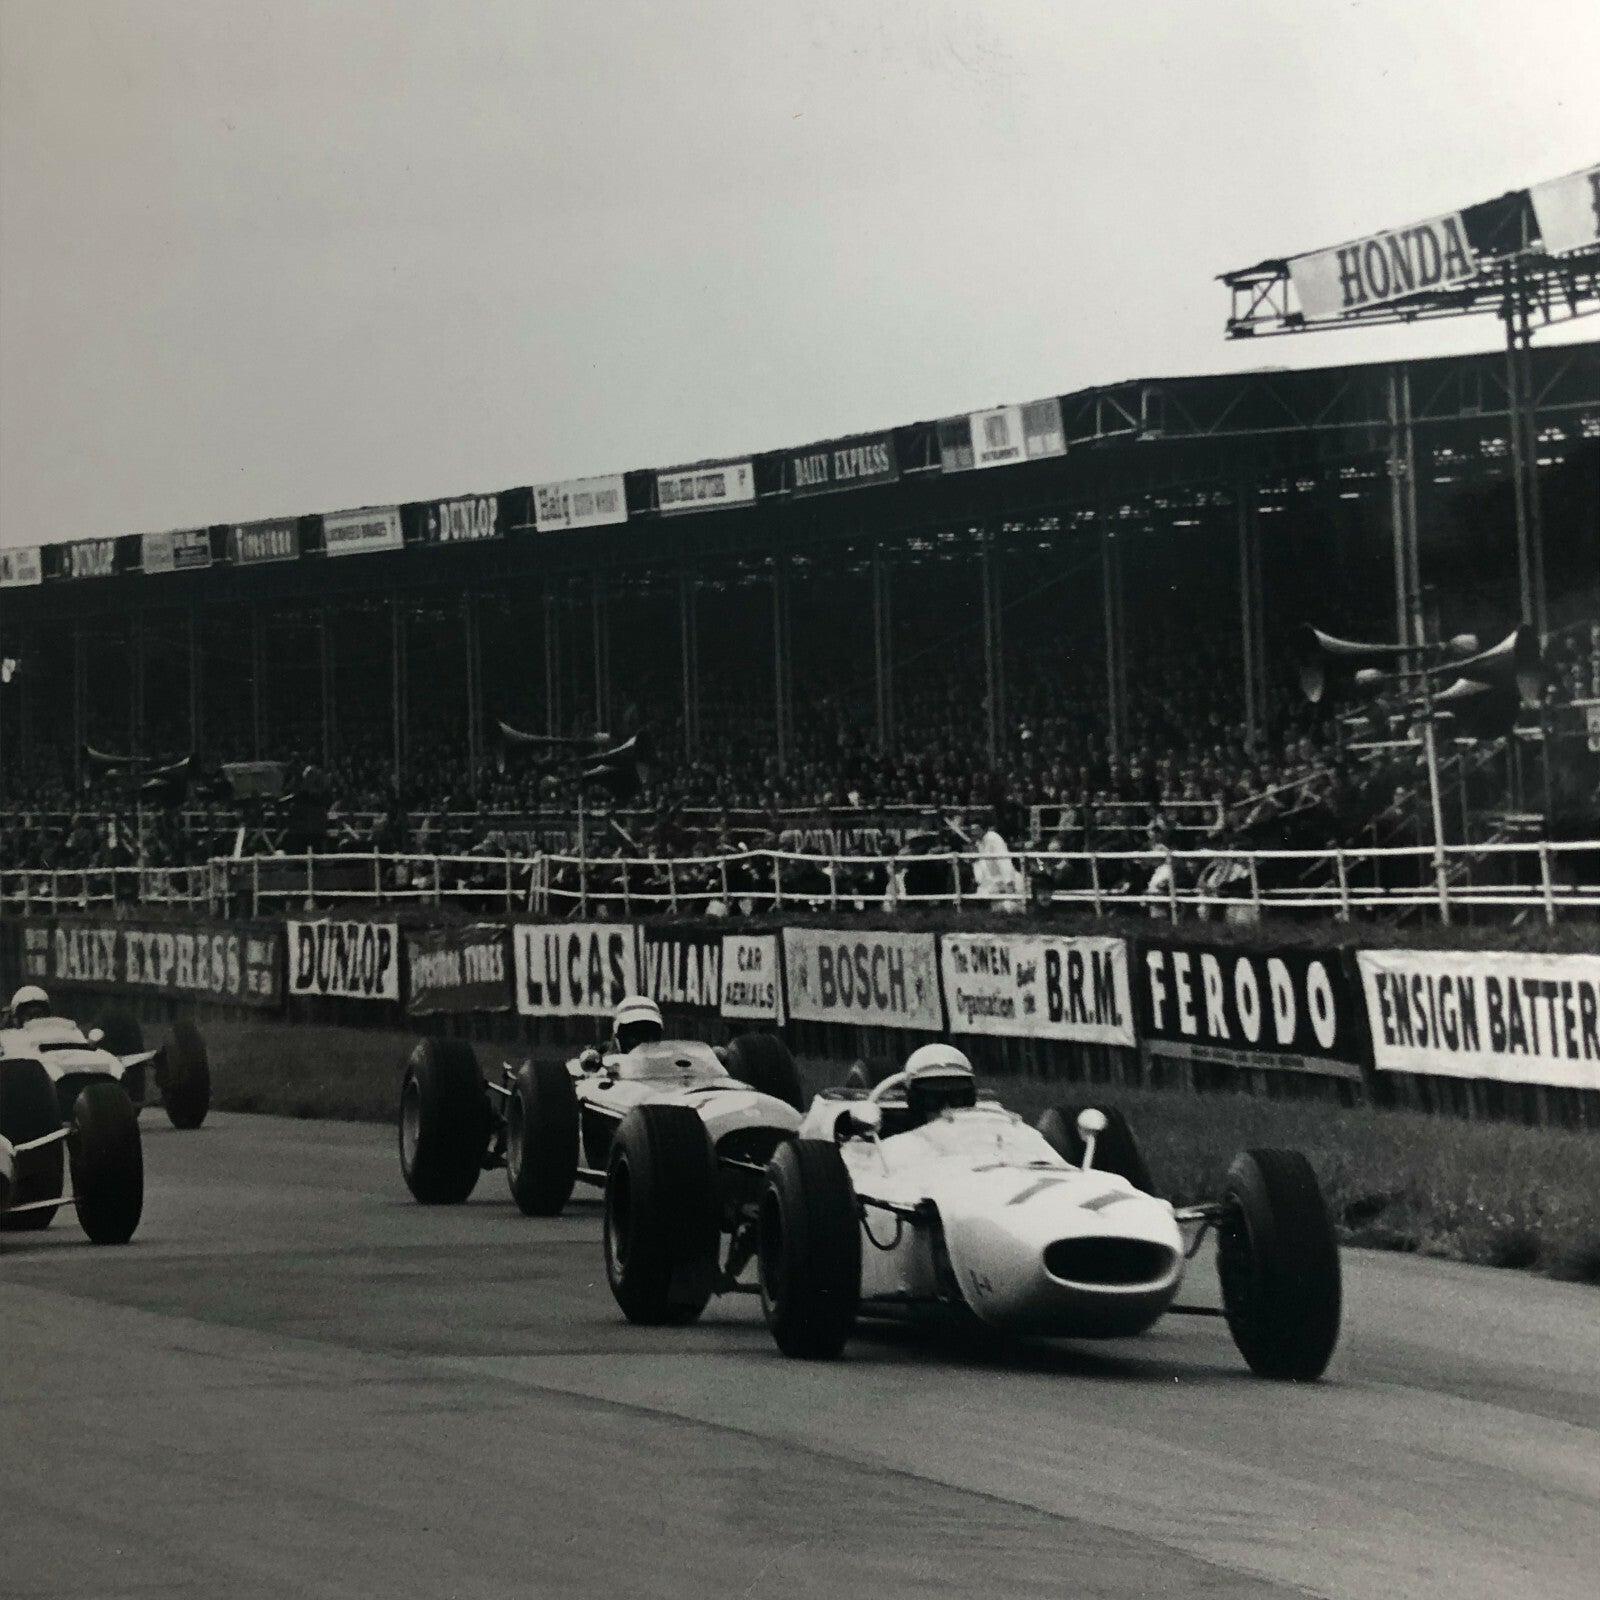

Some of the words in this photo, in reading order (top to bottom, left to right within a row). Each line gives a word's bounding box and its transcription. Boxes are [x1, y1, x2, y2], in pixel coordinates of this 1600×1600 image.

[1337, 215, 1473, 306] HONDA
[794, 453, 829, 487] DAILY
[834, 443, 890, 480] EXPRESS
[439, 497, 498, 541] DUNLOP
[55, 928, 117, 981] DAILY
[124, 930, 241, 995] EXPRESS
[296, 924, 391, 995] DUNLOP
[525, 931, 626, 1006] LUCAS
[737, 945, 762, 971] CAR
[818, 943, 907, 1013] BOSCH
[1147, 950, 1336, 1049] FERODO
[1375, 973, 1481, 1052] ENSIGN
